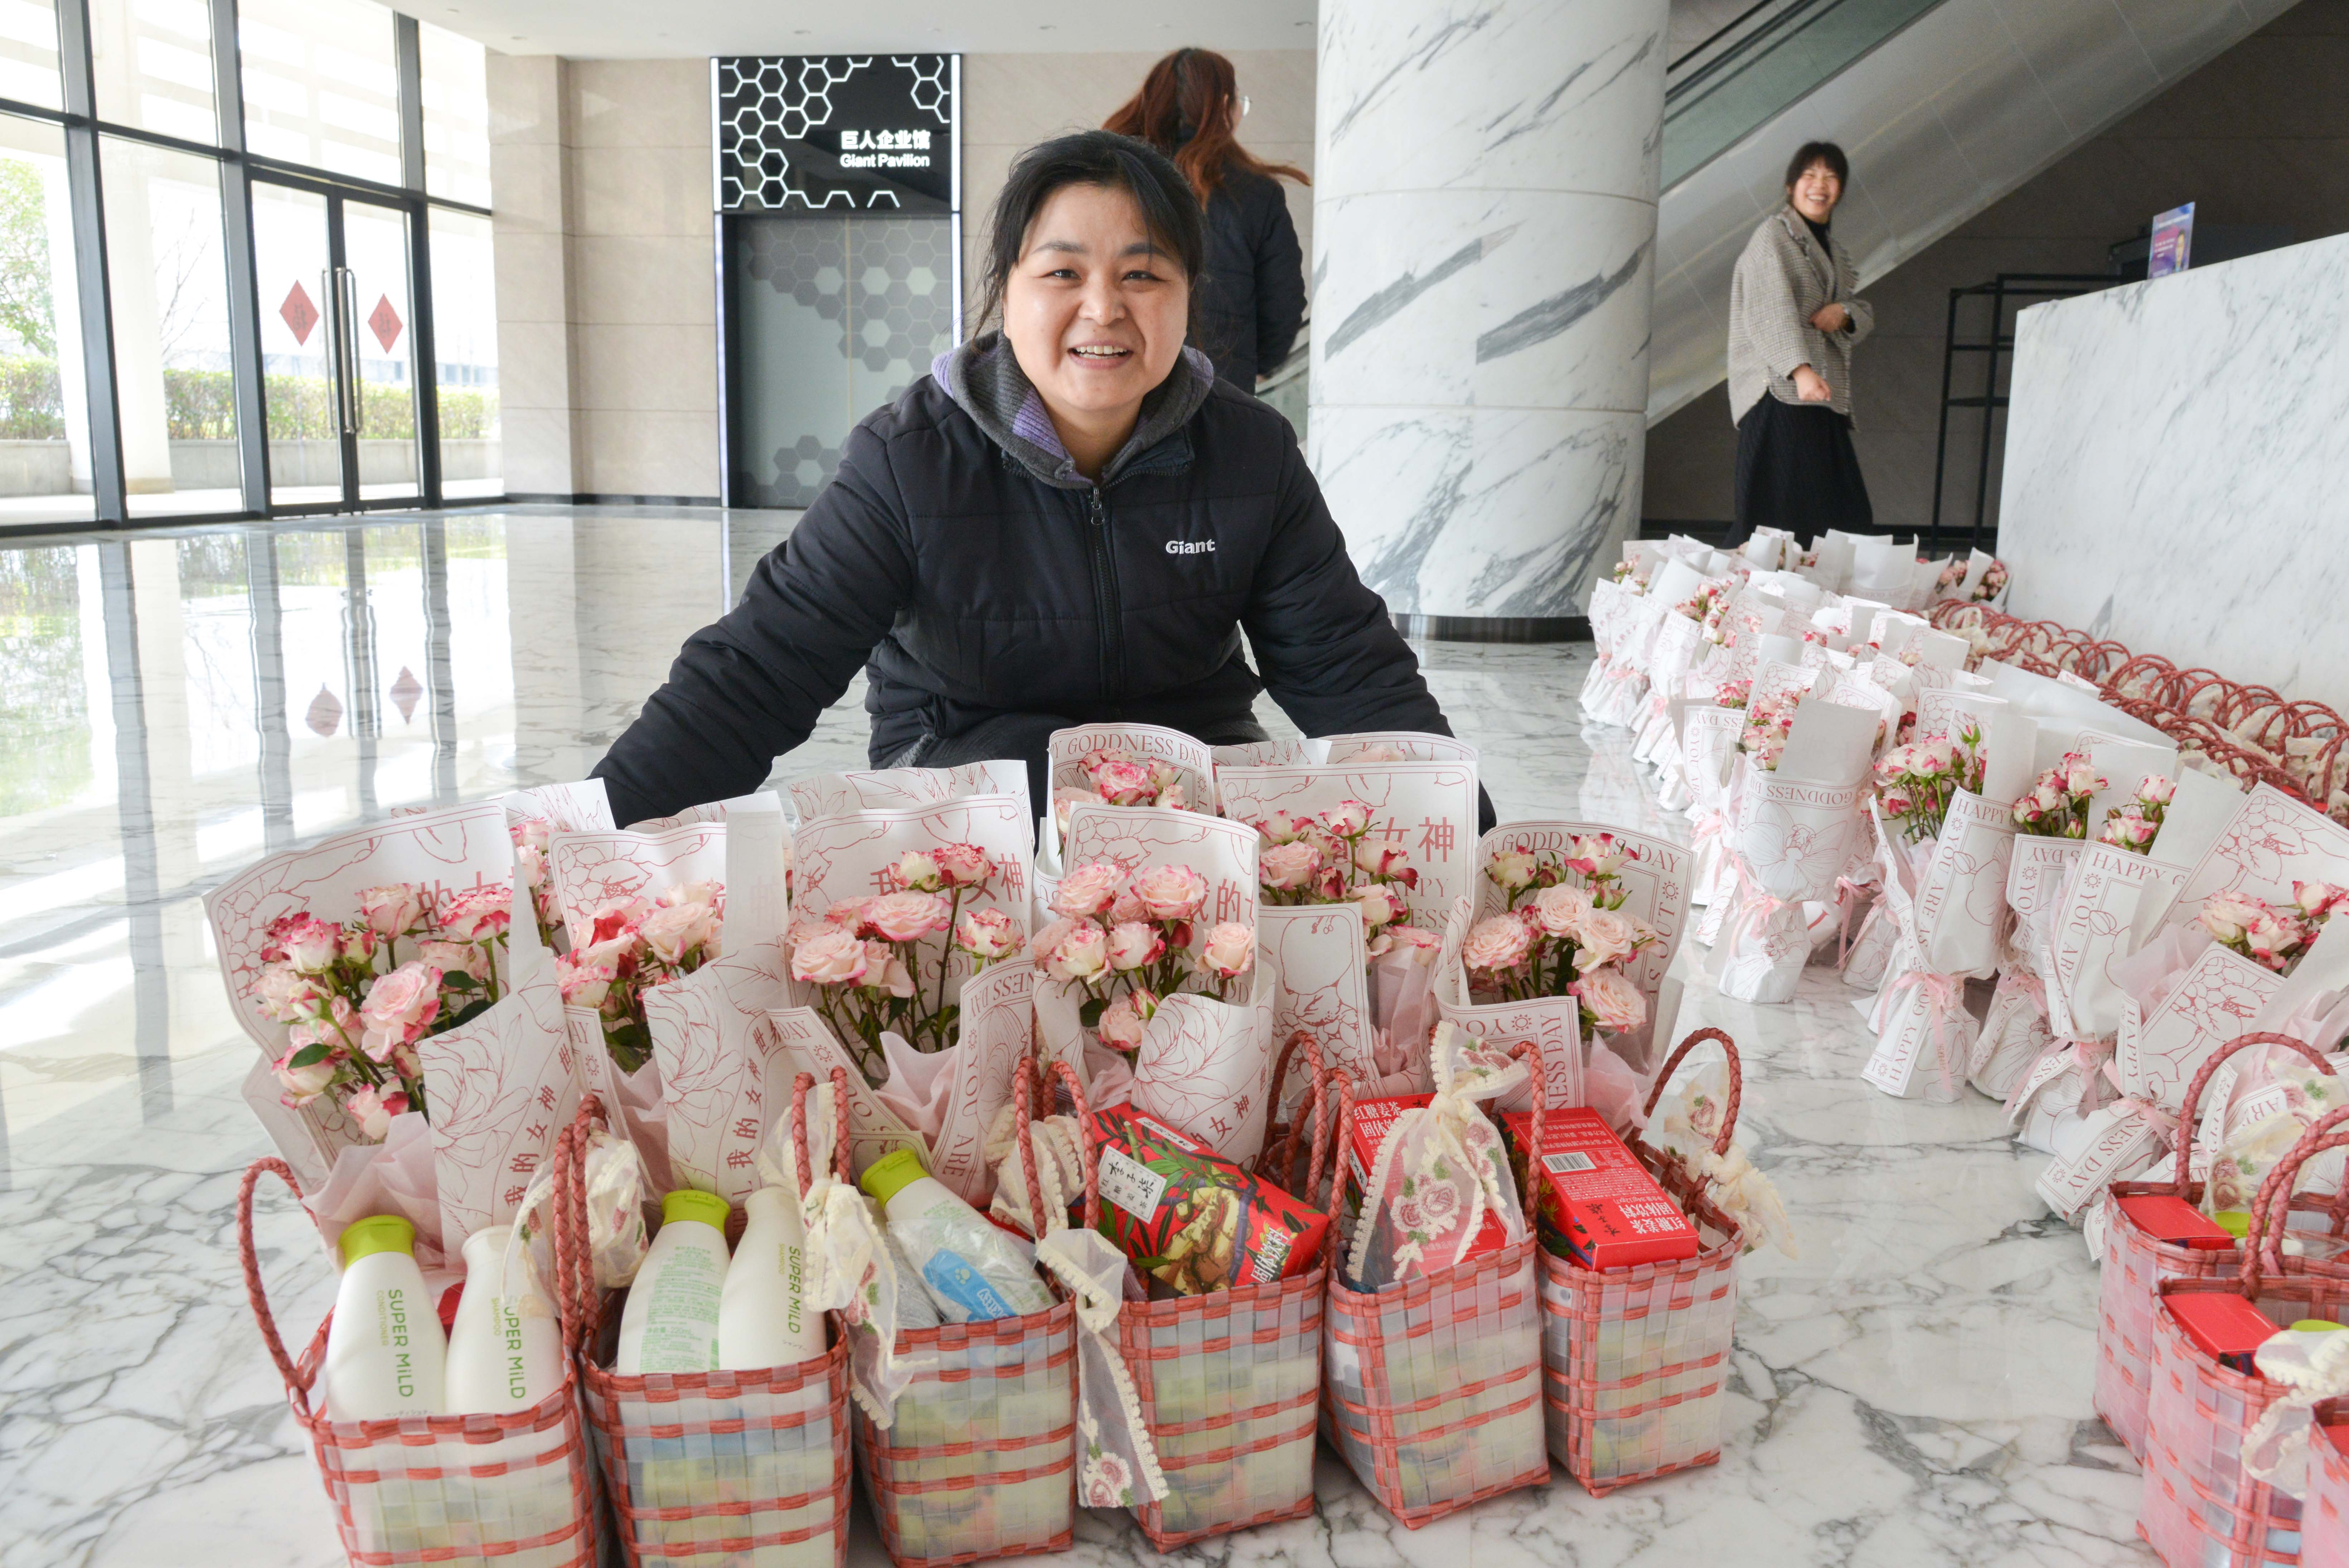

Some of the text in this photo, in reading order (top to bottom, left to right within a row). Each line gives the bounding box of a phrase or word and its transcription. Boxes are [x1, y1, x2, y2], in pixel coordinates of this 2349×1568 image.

[841, 130, 930, 150] 巨人企业馆
[841, 154, 930, 168] Giant Pavilion
[1166, 539, 1215, 554] Giant
[1179, 743, 1204, 769] DAY
[1766, 785, 1853, 805] GODDNESS
[1957, 800, 2007, 824] HAPPY
[1638, 844, 1682, 874] DAY
[1937, 836, 1959, 875] YOU
[2091, 852, 2166, 880] HAPPY
[1922, 879, 1944, 919] ARE
[2068, 894, 2097, 937] YOU
[1540, 1014, 1564, 1055] DAY
[1889, 1026, 1917, 1082] HAPPY
[962, 1060, 979, 1117] YOU
[1354, 1101, 1402, 1121] 红糖姜茶
[943, 1133, 974, 1178] ARE
[2067, 1157, 2102, 1196] DAY
[1619, 1201, 1675, 1218] 固体饮料
[1633, 1217, 1686, 1235] 红糖姜茶
[788, 1246, 801, 1293] SUPER
[1250, 1226, 1292, 1283] 固体饮料
[377, 1290, 389, 1347] CONDITIONER
[387, 1289, 410, 1347] SUPER
